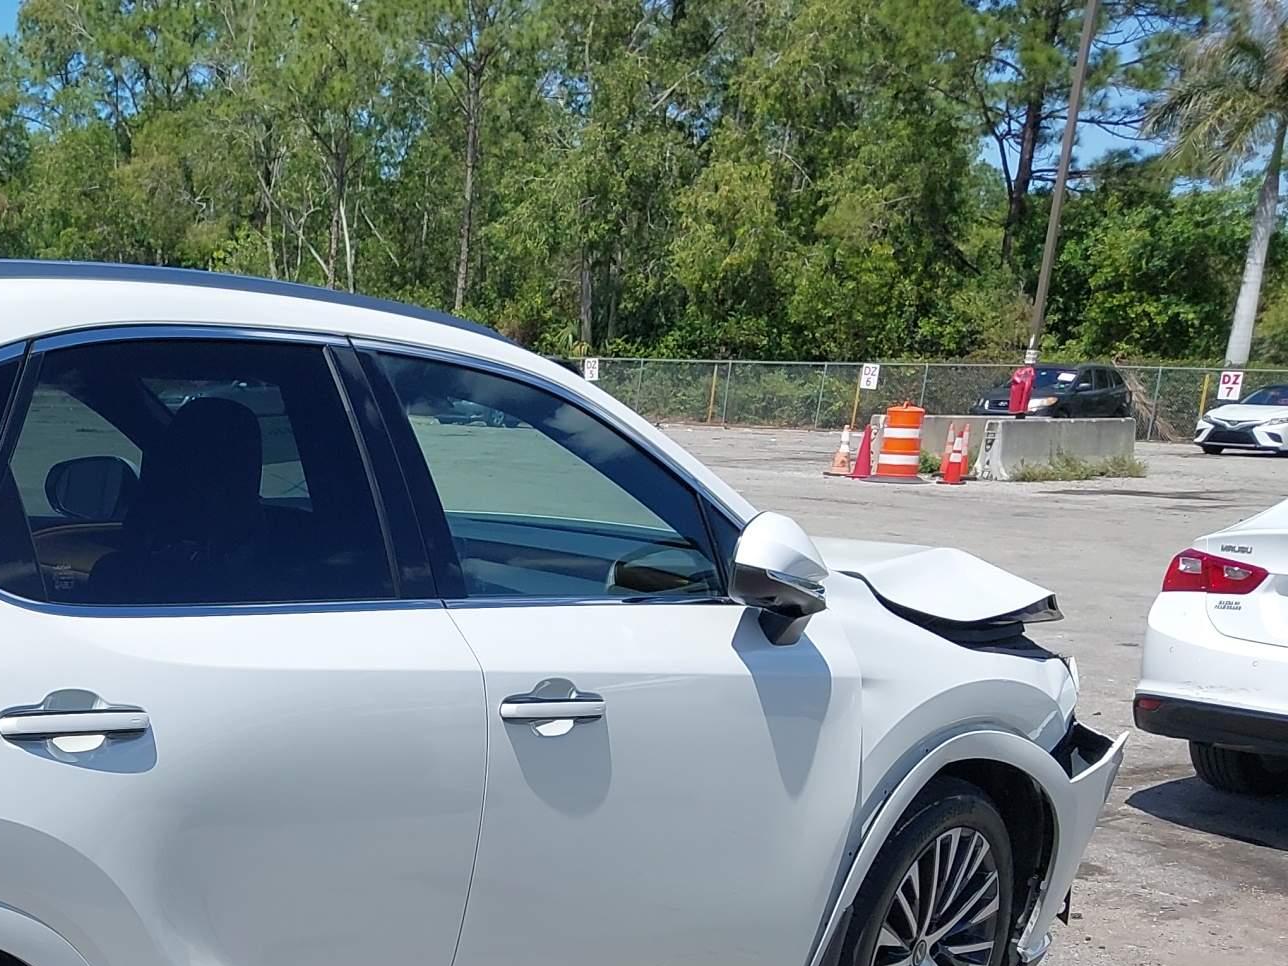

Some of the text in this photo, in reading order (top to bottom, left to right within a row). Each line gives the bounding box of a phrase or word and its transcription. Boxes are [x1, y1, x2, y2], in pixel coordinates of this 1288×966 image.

[586, 360, 597, 369] DZ
[589, 370, 594, 378] 5
[864, 366, 877, 376] DZ
[865, 377, 872, 386] 6
[1222, 374, 1241, 385] DZ
[1225, 386, 1234, 397] 7
